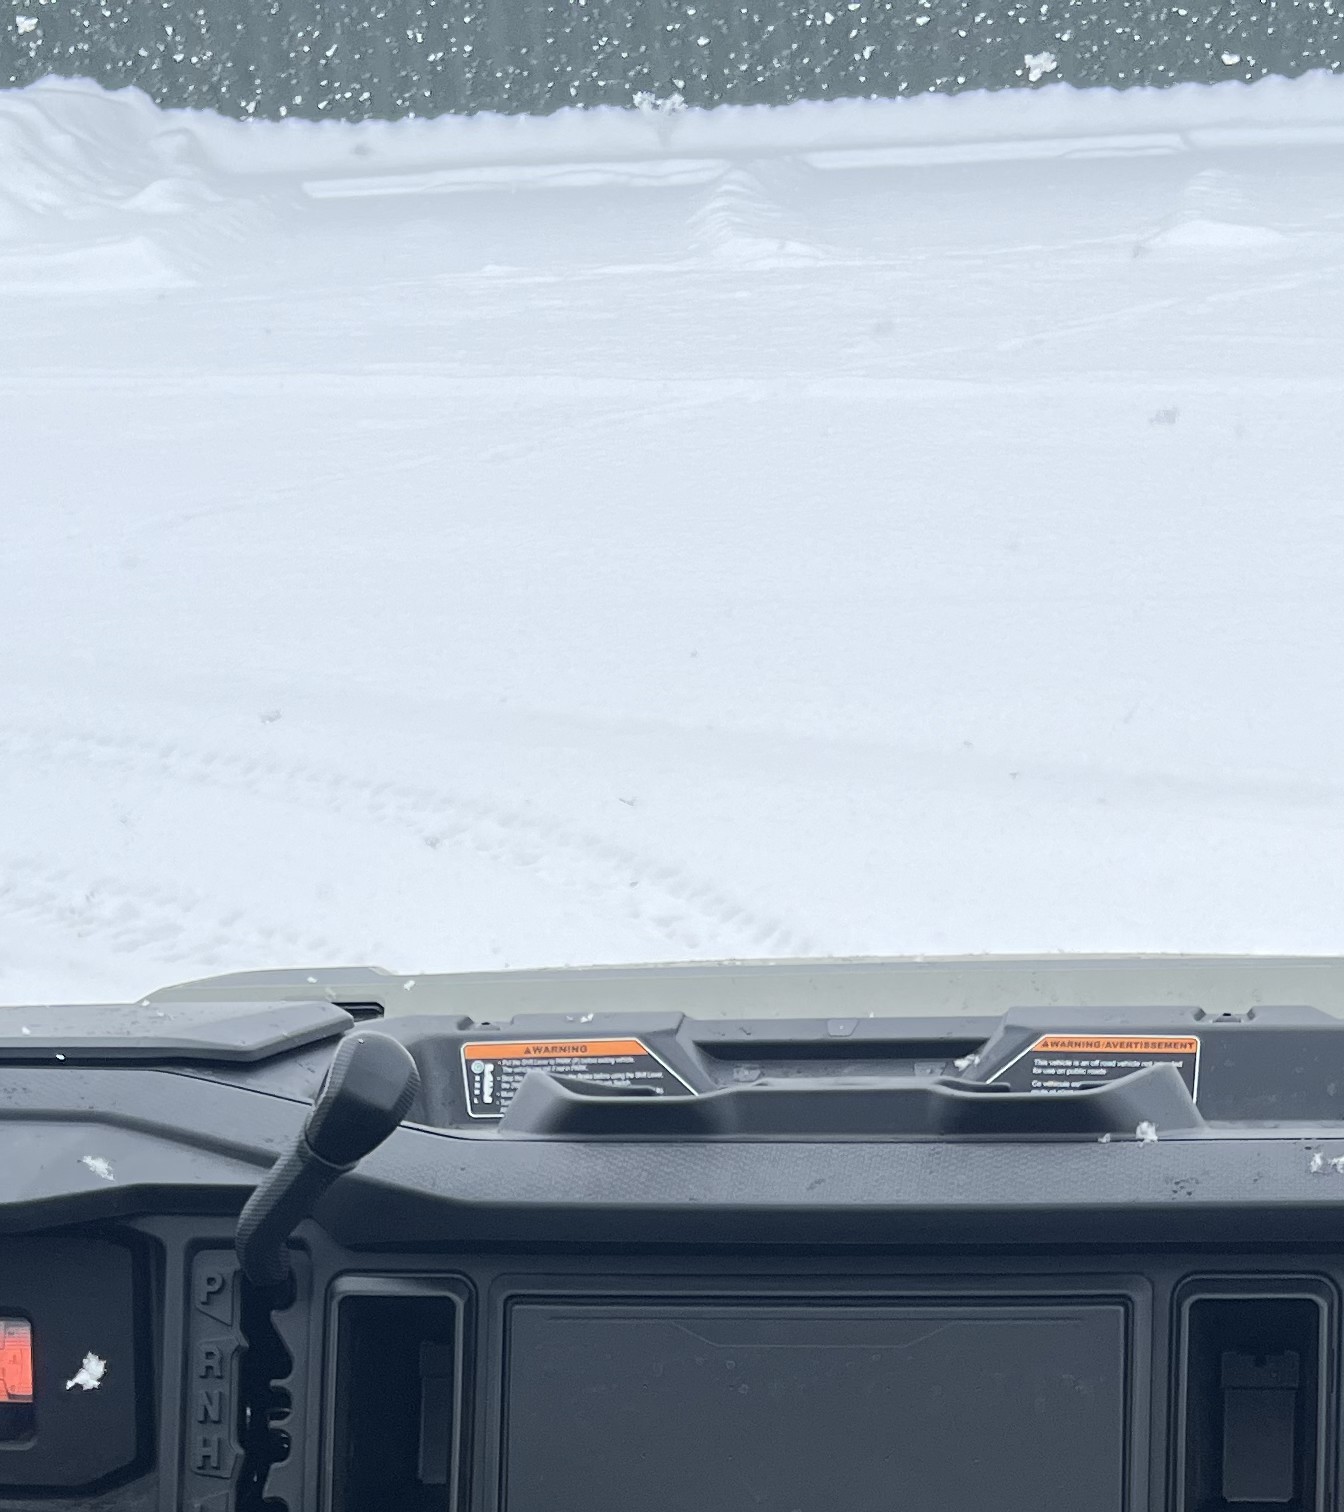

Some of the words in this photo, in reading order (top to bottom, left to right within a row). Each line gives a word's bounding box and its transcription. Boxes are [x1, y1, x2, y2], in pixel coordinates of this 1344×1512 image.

[532, 1044, 588, 1054] WARNING
[201, 1272, 223, 1305] P
[199, 1347, 223, 1379] R
[198, 1391, 221, 1424] N
[197, 1436, 220, 1470] H
